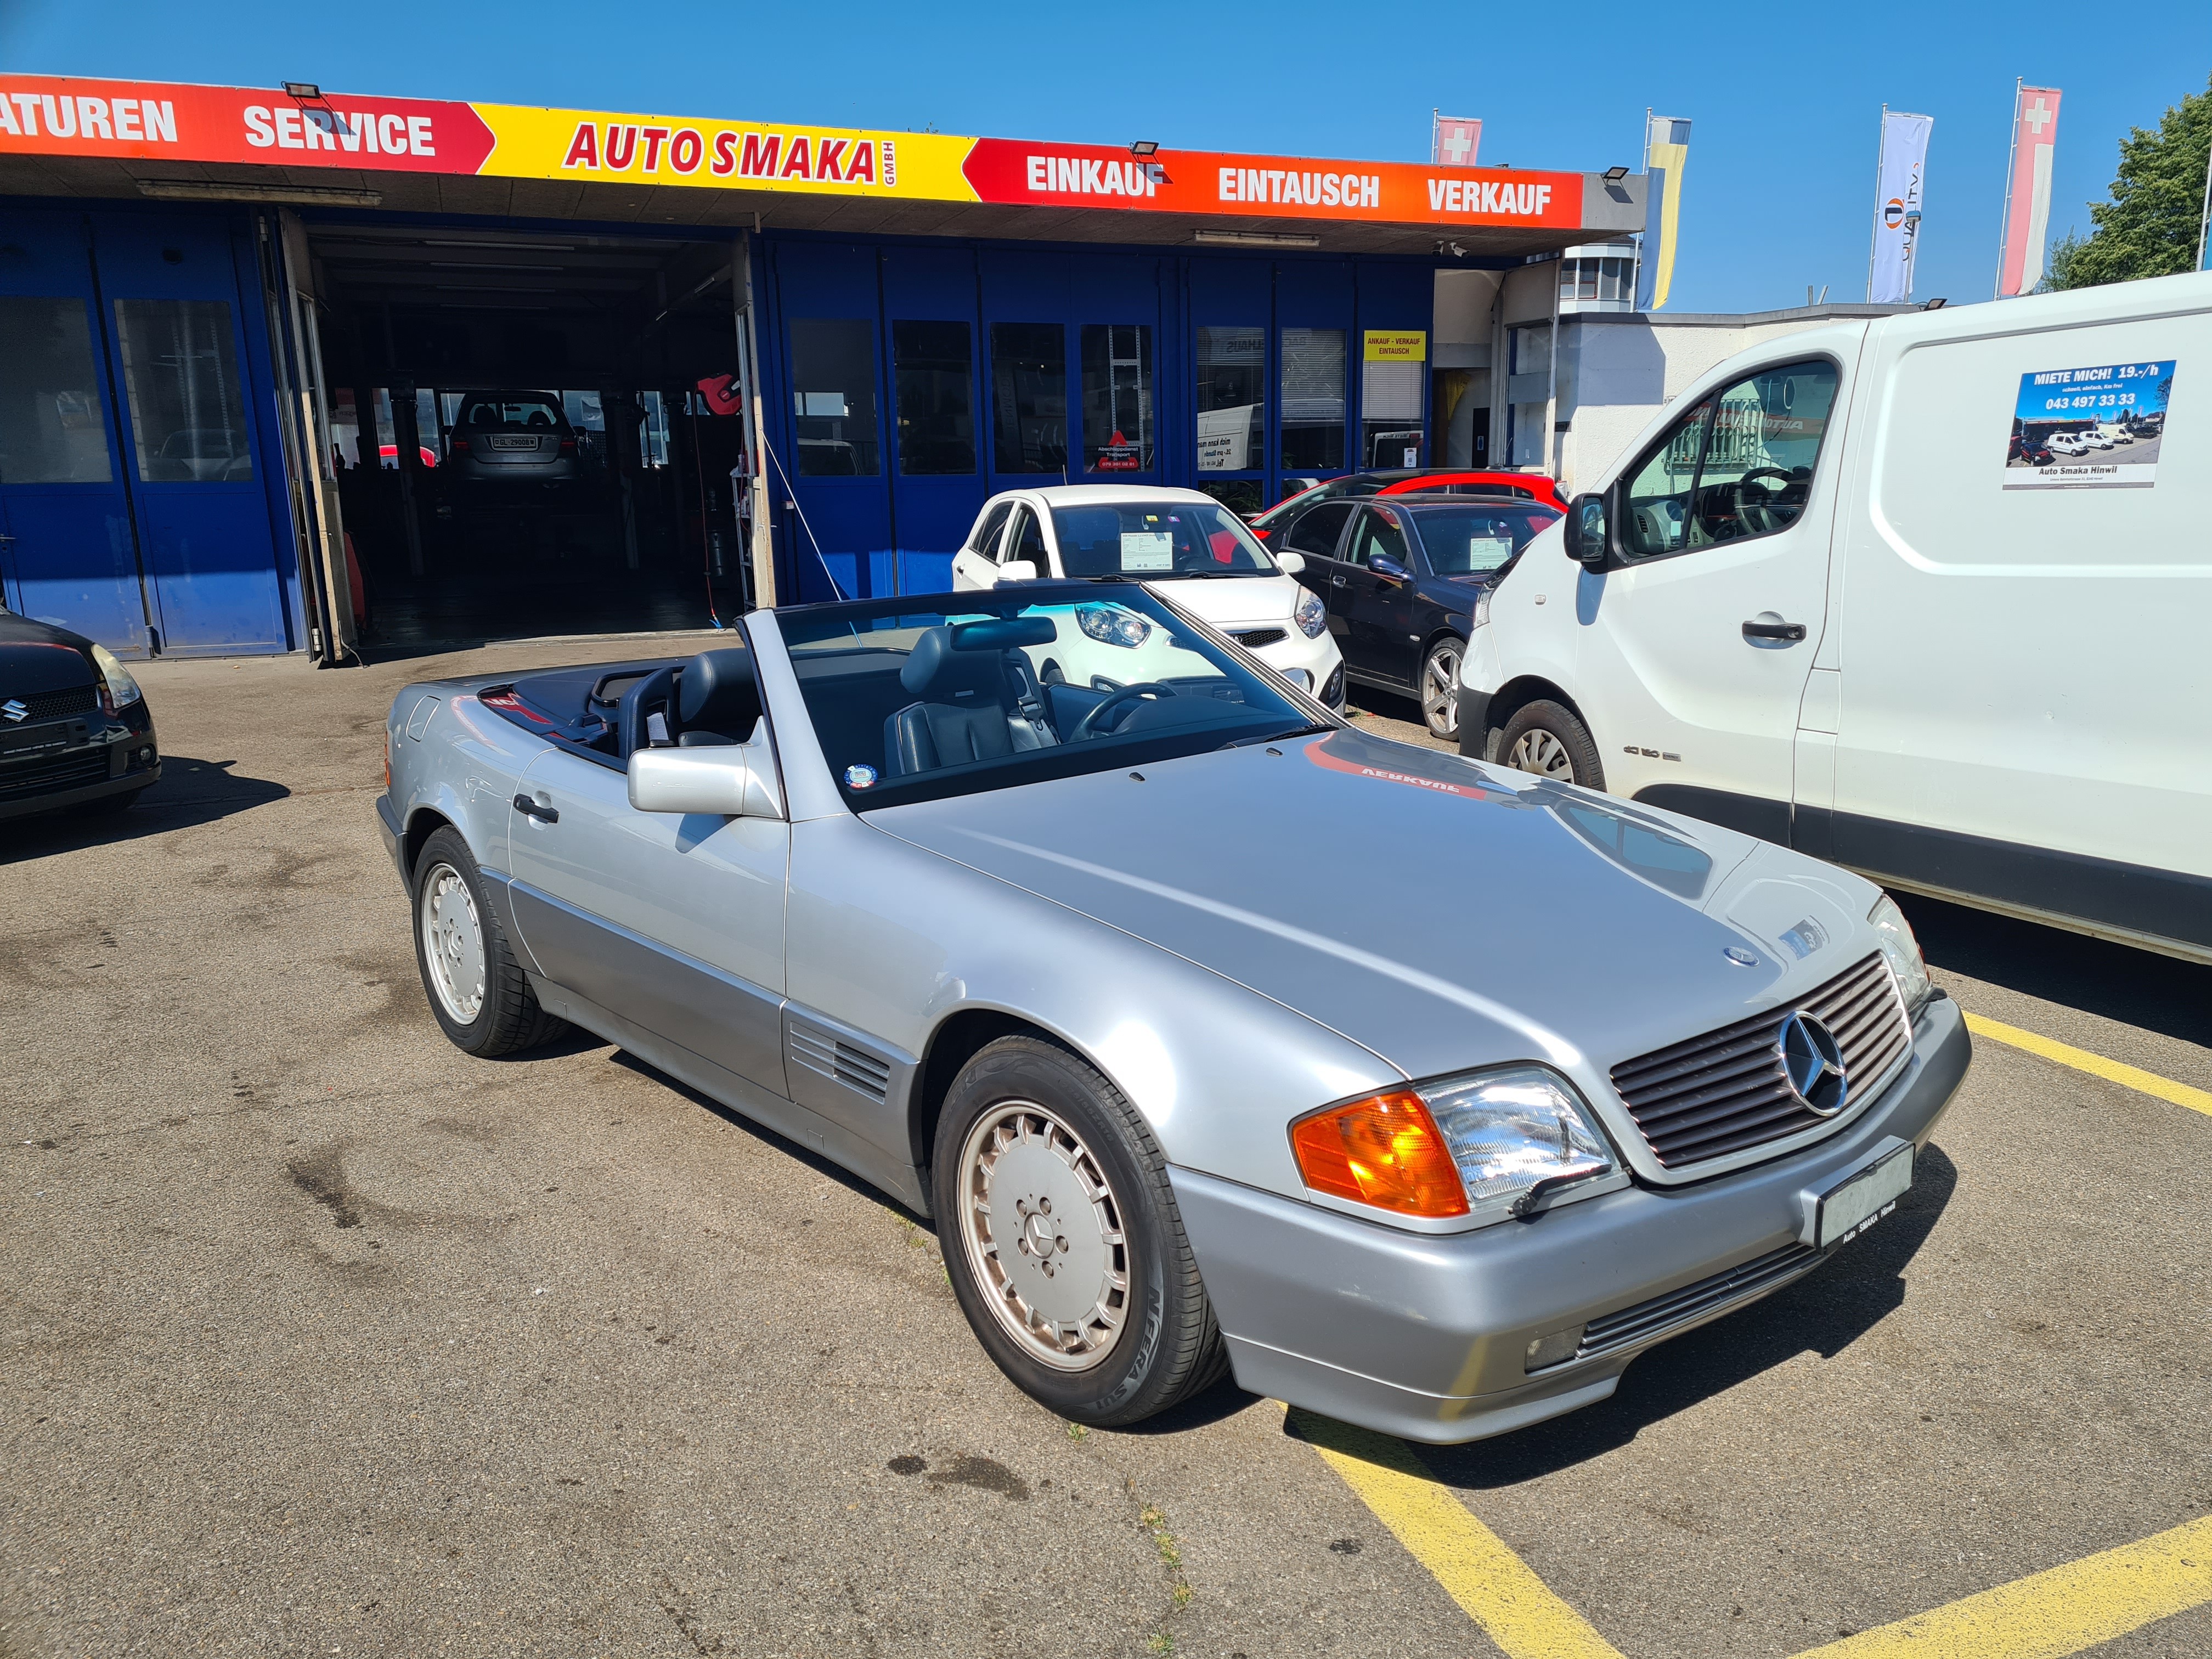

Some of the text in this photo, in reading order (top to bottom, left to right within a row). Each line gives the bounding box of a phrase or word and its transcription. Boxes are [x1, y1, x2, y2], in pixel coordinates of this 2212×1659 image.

[243, 105, 436, 157] SERVICE
[562, 122, 876, 185] AUTO SMAKA
[883, 142, 895, 185] GMBH
[1027, 155, 1164, 197] EINKAUF
[1218, 167, 1379, 207] EINTAUSCH
[1427, 179, 1551, 216] VERKAUF
[2034, 364, 2159, 385] MIETE MICH! 19.-/h
[2046, 393, 2136, 410] 043 497 33 33
[2090, 466, 2118, 474] Hinwil
[1843, 1231, 1856, 1244] Auto
[1859, 1213, 1878, 1233] SMAKA
